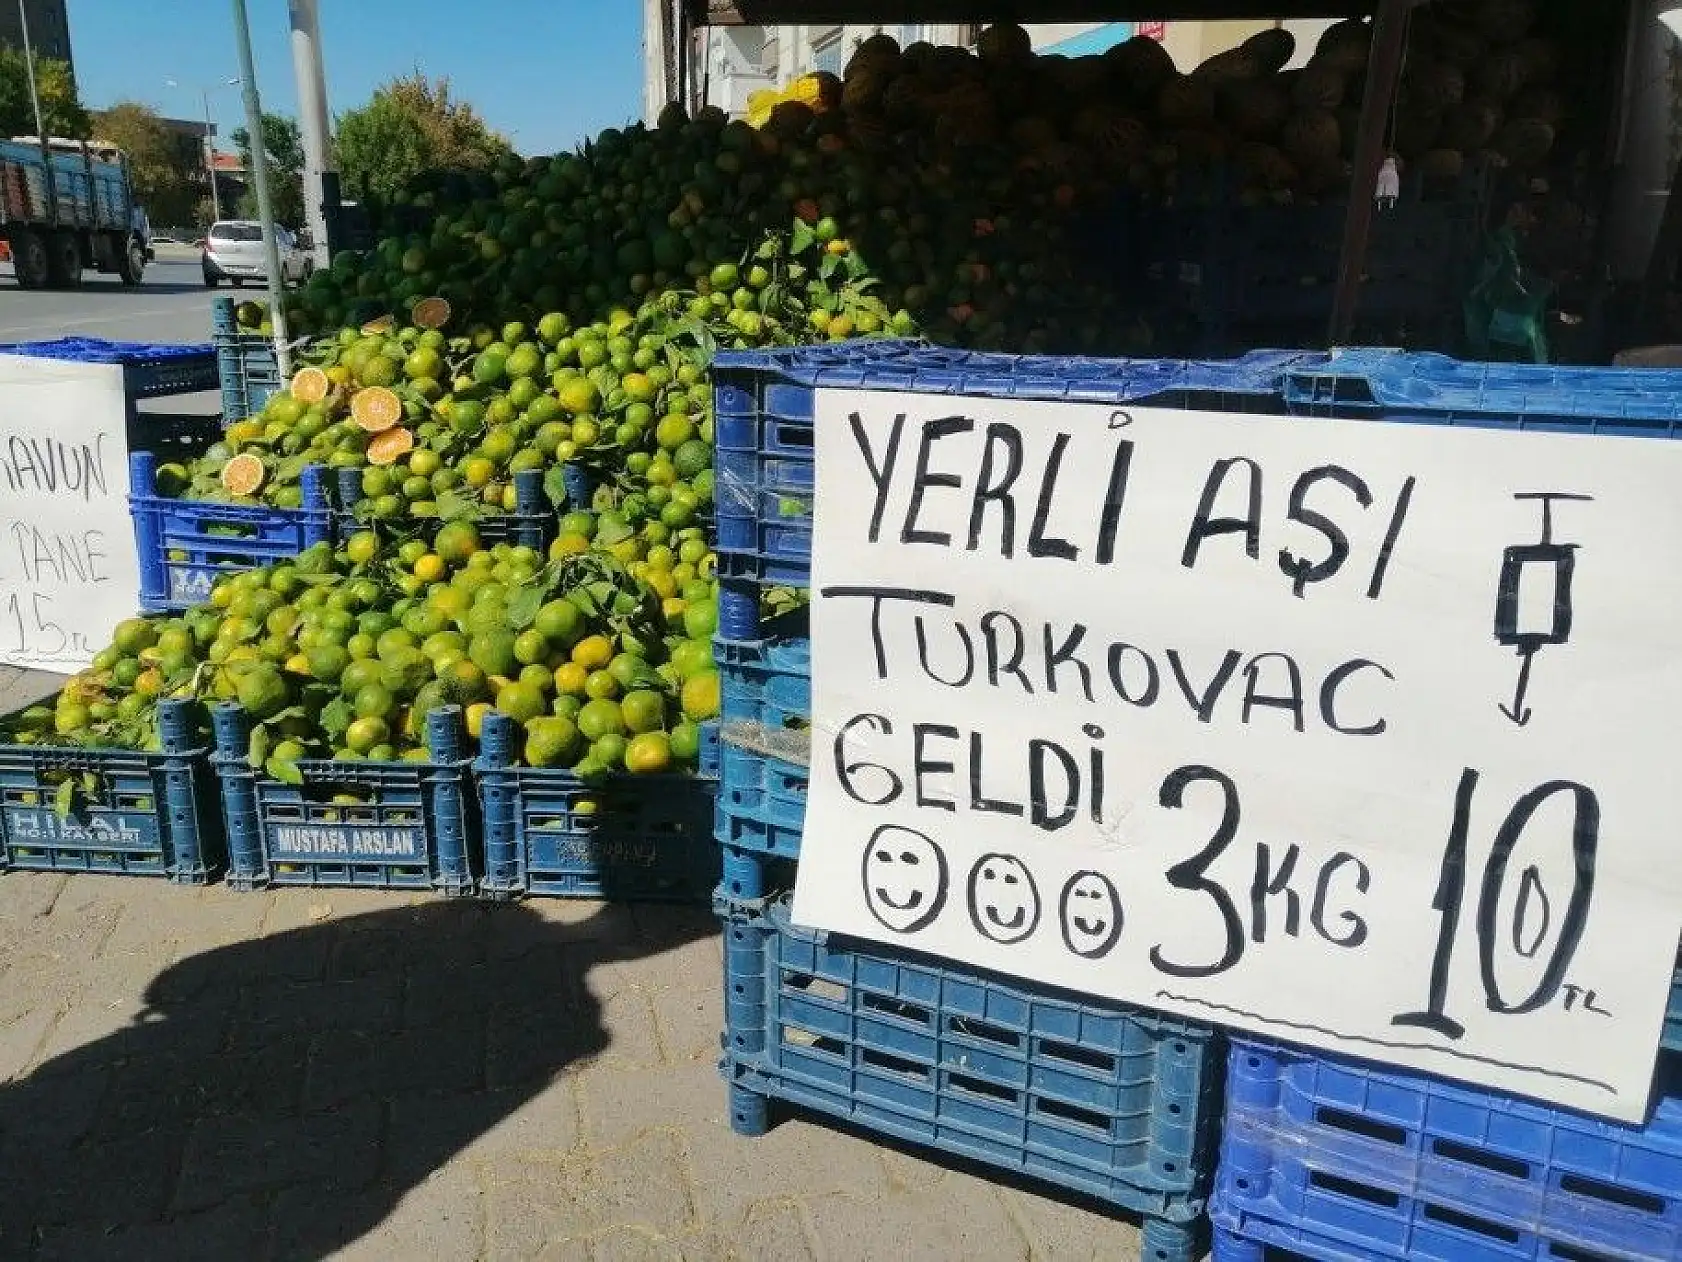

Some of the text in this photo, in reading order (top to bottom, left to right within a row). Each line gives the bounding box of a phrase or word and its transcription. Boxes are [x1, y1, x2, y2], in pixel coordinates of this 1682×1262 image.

[848, 411, 1416, 600] YERLİ AŞI
[820, 586, 1397, 736] TURKOVAC
[834, 713, 1105, 832] GELDİ
[277, 826, 414, 855] MUSTAFA ARSLAN
